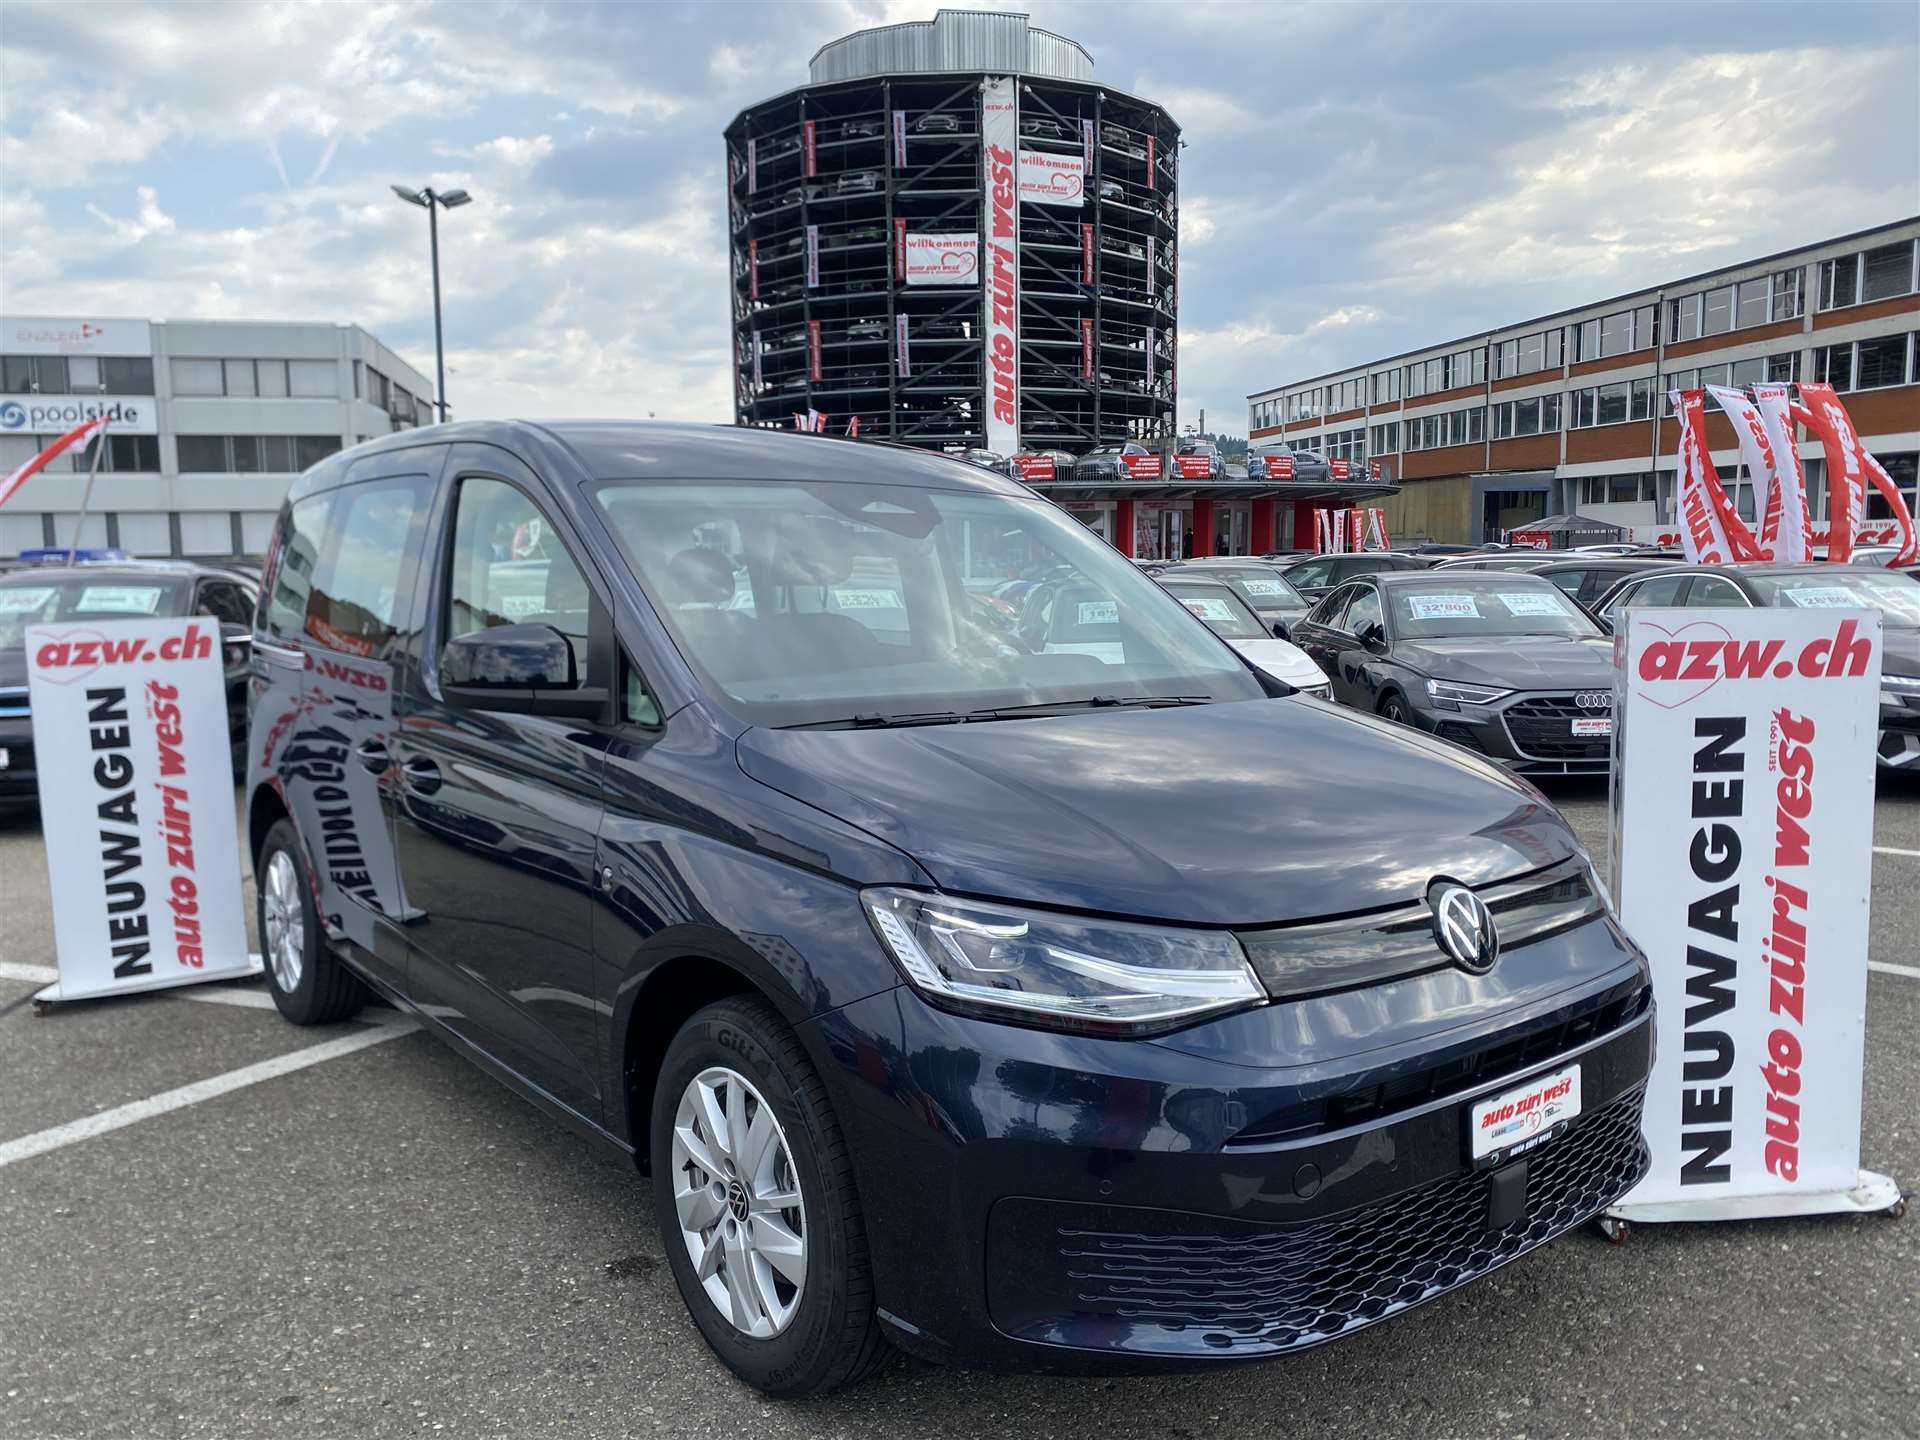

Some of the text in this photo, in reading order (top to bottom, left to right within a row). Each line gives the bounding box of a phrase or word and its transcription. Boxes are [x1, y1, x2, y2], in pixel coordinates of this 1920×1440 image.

[985, 103, 1013, 112] azw.ch
[1021, 156, 1081, 170] willkommen
[908, 239, 976, 248] willkommen
[988, 144, 1015, 426] auto züri west
[31, 401, 137, 429] poolside
[1824, 401, 1861, 475] west
[36, 625, 212, 669] azw.ch
[1637, 619, 1872, 682] azw.ch
[1769, 719, 1779, 772] SEIT 1991
[86, 687, 153, 980] NEUWAGEN
[146, 679, 205, 969] auto züri west
[1680, 716, 1747, 1186] NEUWAGEN
[1759, 707, 1816, 1183] auto züri west
[1481, 1103, 1515, 1129] auto
[1515, 1089, 1542, 1117] züri
[1543, 1077, 1572, 1102] west
